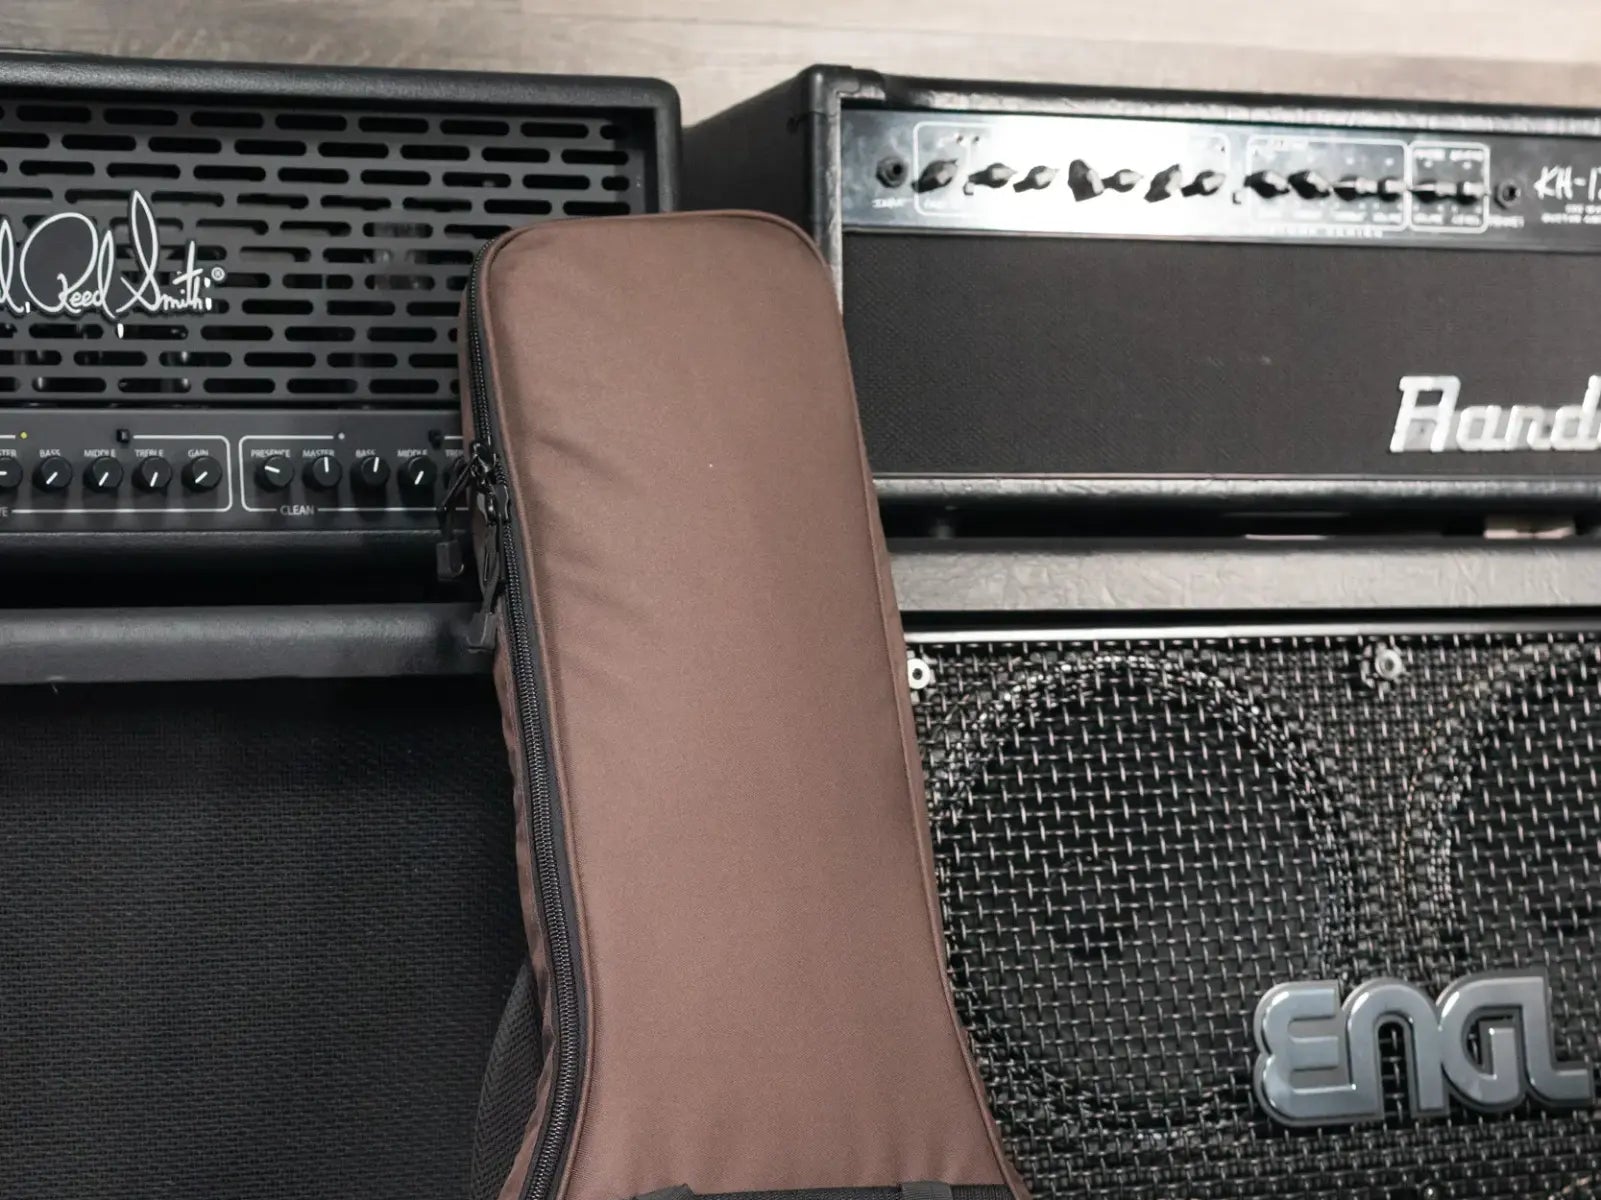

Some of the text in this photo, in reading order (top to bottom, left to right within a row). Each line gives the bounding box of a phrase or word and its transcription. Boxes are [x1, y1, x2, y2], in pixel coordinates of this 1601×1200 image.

[20, 211, 118, 319] Reed
[115, 189, 204, 312] Smith
[39, 448, 61, 458] BASS
[279, 504, 315, 516] CLEAN
[1253, 966, 1593, 1128] ENGL
